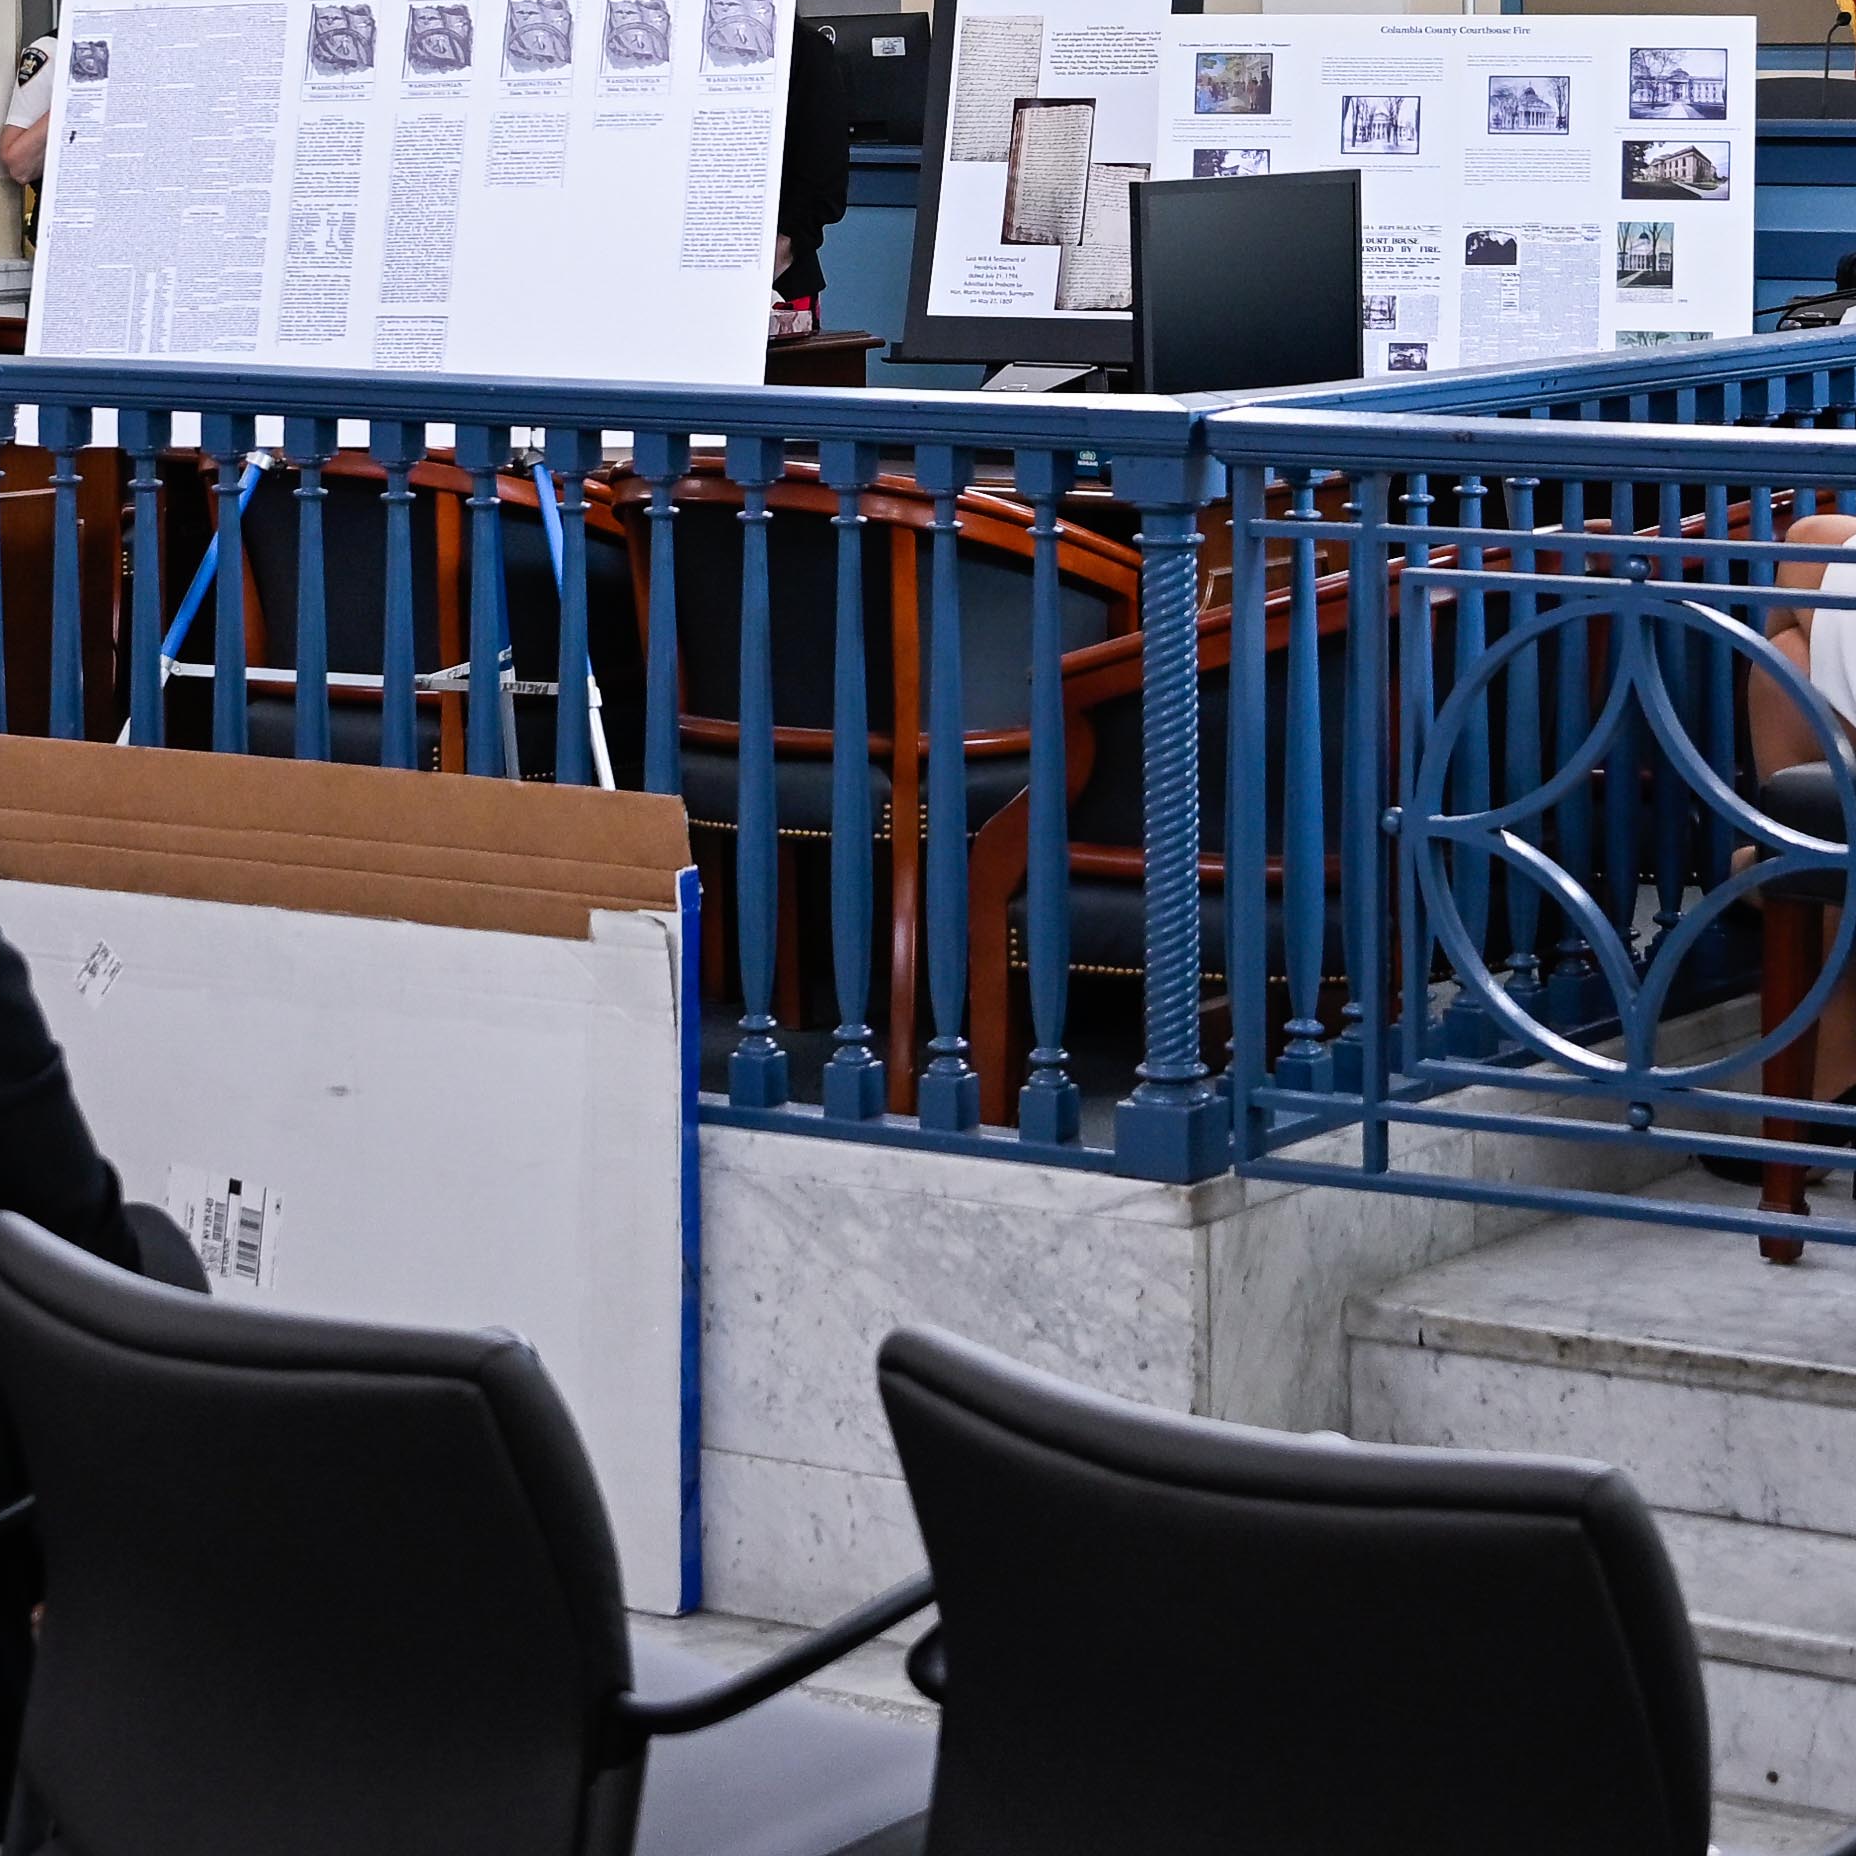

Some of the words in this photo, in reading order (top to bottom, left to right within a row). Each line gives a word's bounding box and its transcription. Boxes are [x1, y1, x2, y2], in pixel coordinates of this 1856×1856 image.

[1380, 26, 1422, 34] Columbia
[1425, 26, 1457, 36] County
[1459, 26, 1511, 34] Courthouse
[1513, 26, 1531, 34] Fire
